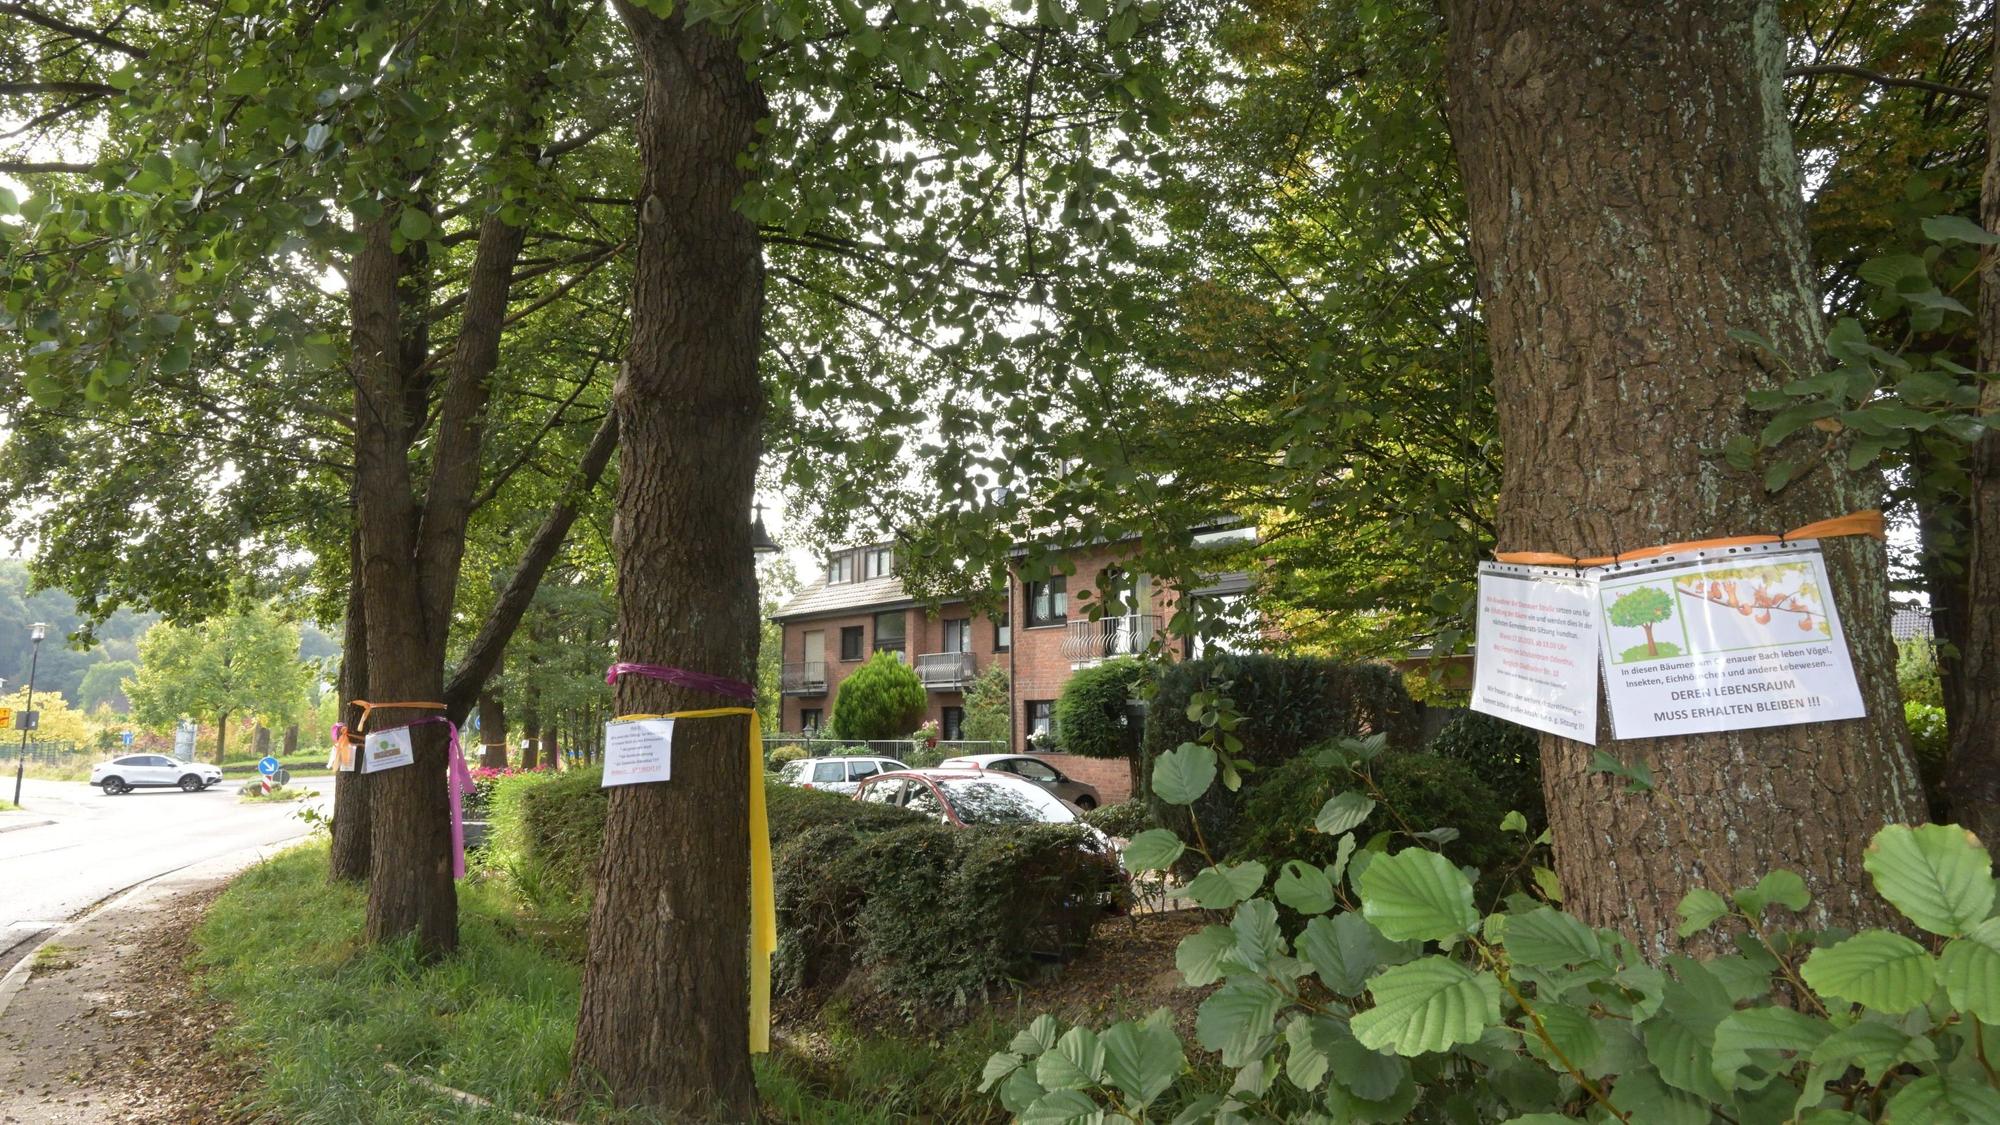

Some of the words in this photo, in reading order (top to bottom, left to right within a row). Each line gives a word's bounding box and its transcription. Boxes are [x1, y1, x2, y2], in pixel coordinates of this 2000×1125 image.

[1631, 665, 1658, 675] diesen
[1660, 662, 1695, 671] Bäumen
[1714, 654, 1756, 664] Oenauer
[1758, 652, 1779, 660] Bach
[1781, 648, 1804, 658] leben
[1806, 646, 1832, 656] Vögel,
[1626, 678, 1664, 688] Insekten,
[1666, 671, 1725, 684] Eichhönchen
[1728, 669, 1745, 677] und
[1748, 665, 1778, 674] andere
[1671, 688, 1711, 701] DEREN
[1714, 680, 1796, 696] LEBENSRAUM
[1654, 710, 1688, 722] MUSS
[1691, 705, 1753, 719] ERHALTEN
[1757, 698, 1805, 712] BLEIBEN
[1808, 696, 1821, 707] !!!
